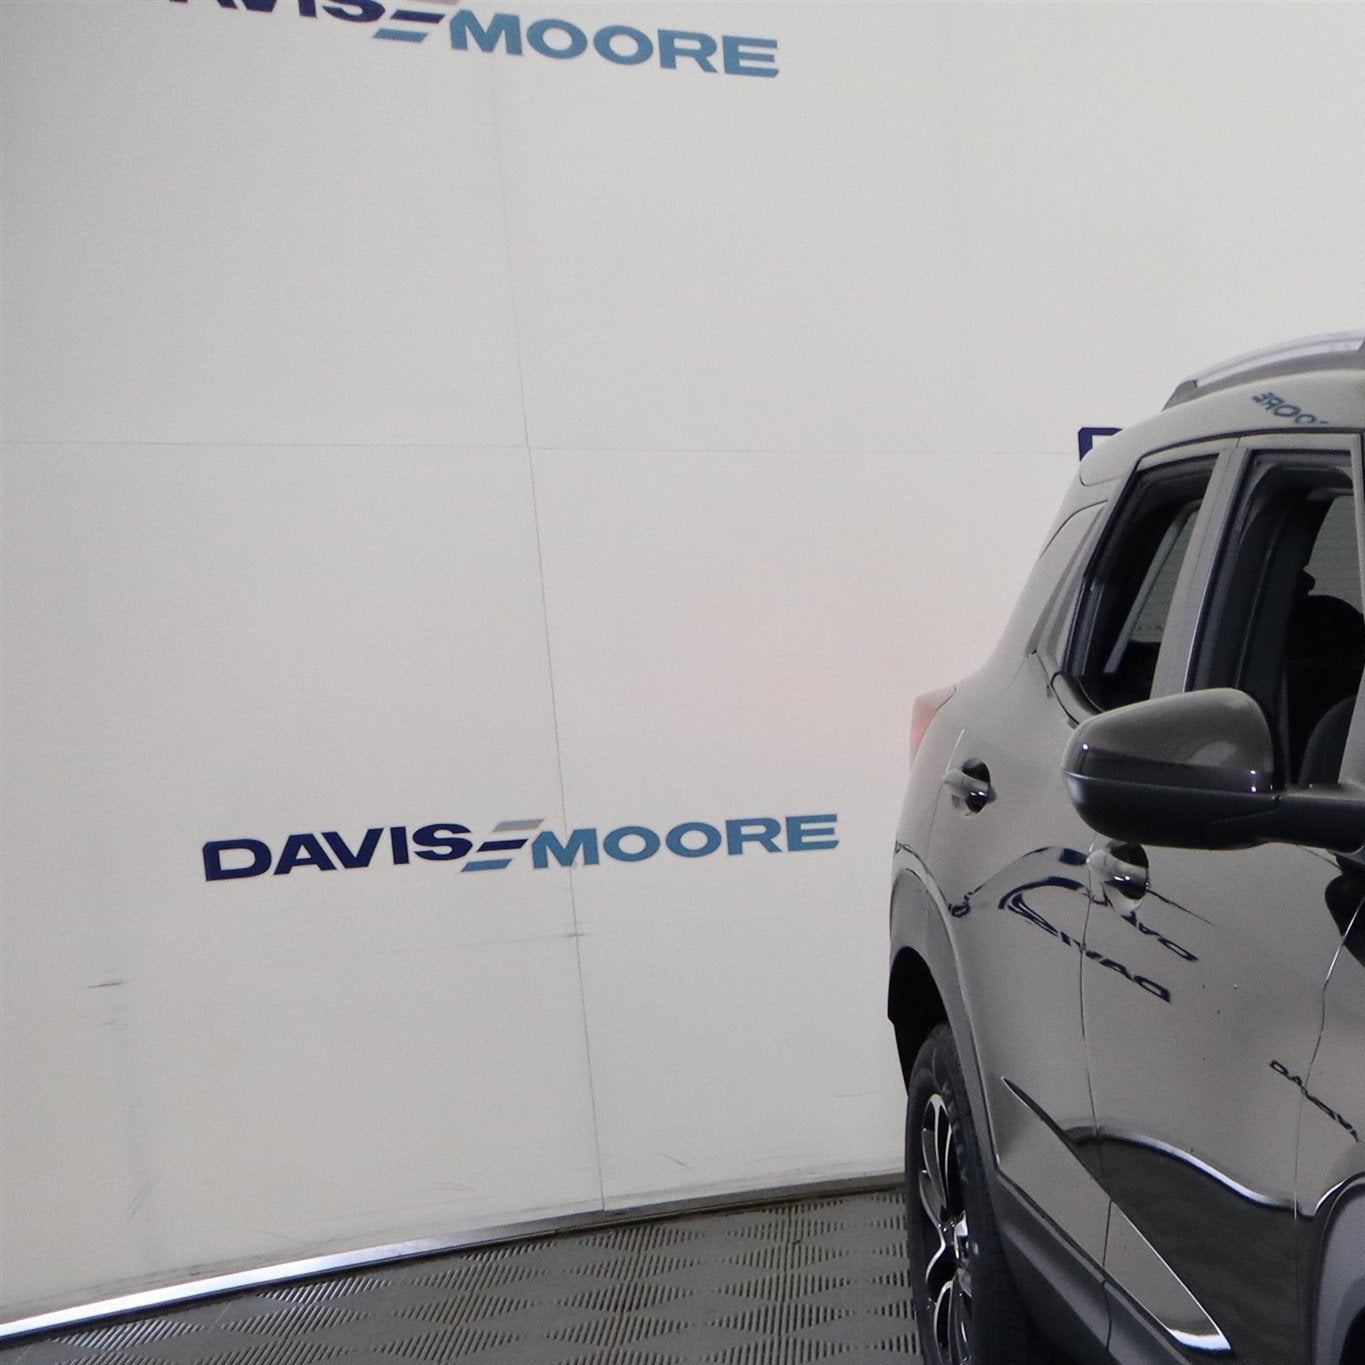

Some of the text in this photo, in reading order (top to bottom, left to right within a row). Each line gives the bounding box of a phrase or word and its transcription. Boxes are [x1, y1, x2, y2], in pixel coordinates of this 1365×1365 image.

[448, 8, 779, 78] MOORE
[202, 813, 840, 881] DAVIS MOORE
